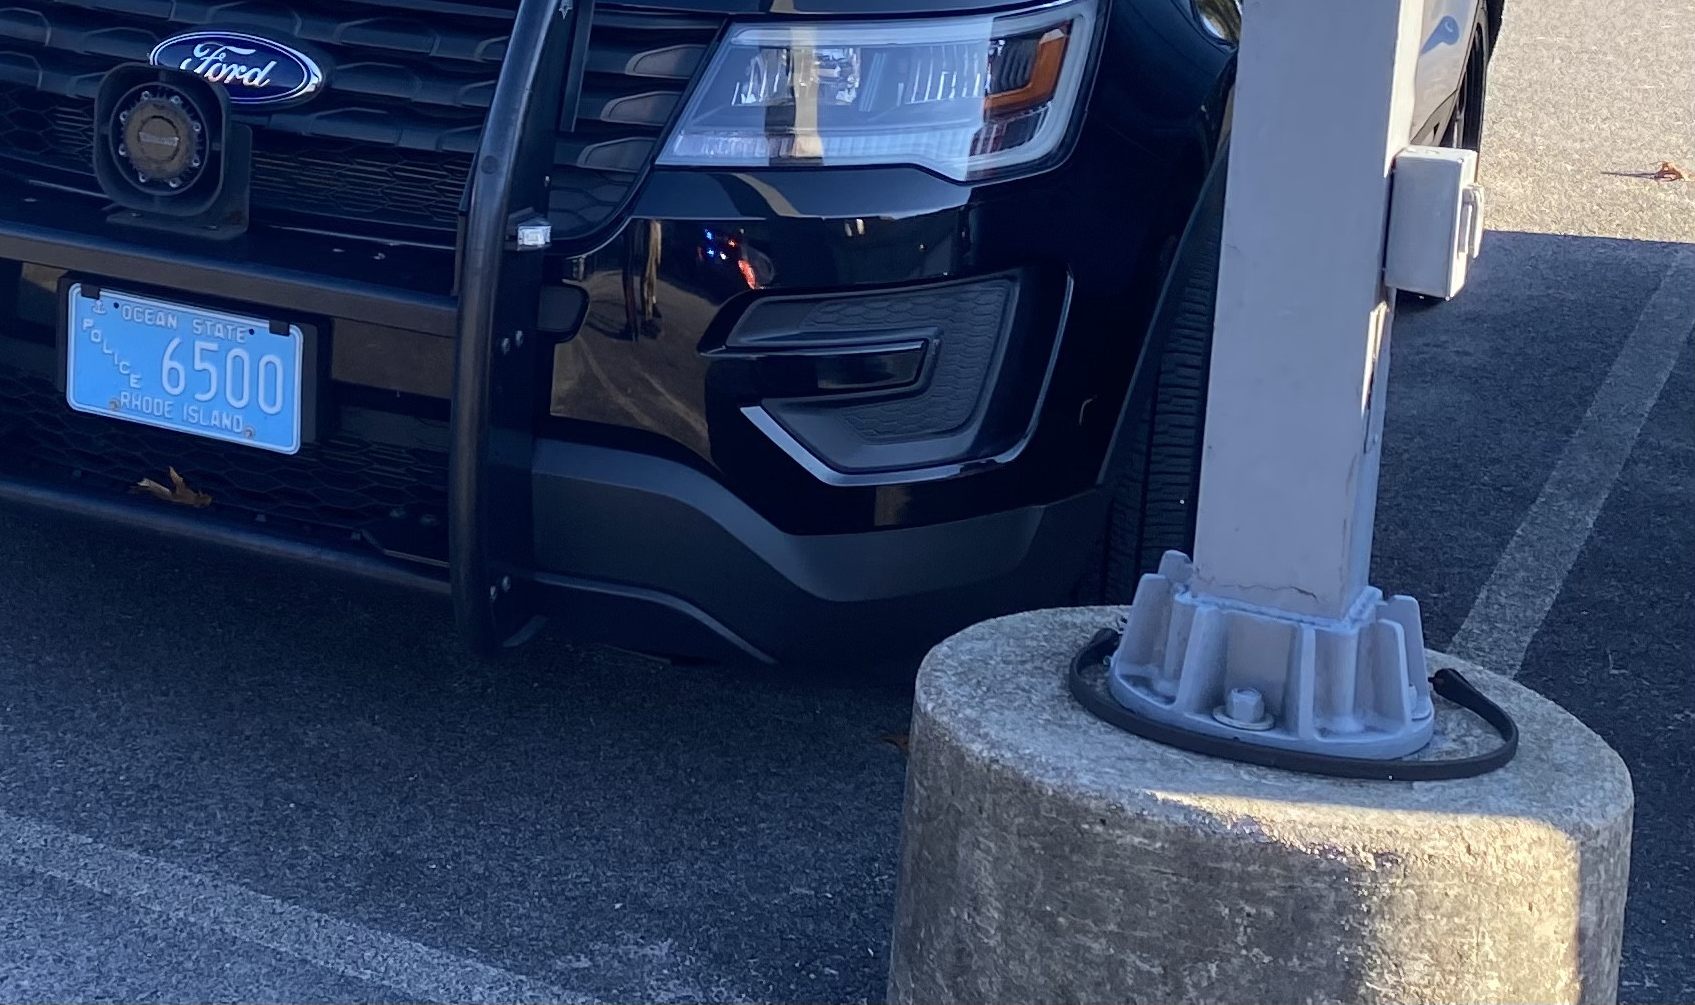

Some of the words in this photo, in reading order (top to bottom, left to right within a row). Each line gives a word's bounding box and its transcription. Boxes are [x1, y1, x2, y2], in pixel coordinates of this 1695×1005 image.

[179, 41, 278, 88] Ford
[121, 305, 178, 330] OCEAN
[192, 318, 247, 343] STATE
[82, 318, 143, 389] POLICE
[161, 337, 284, 415] 6500
[119, 391, 175, 419] RHODE
[183, 403, 244, 434] ISLAND
